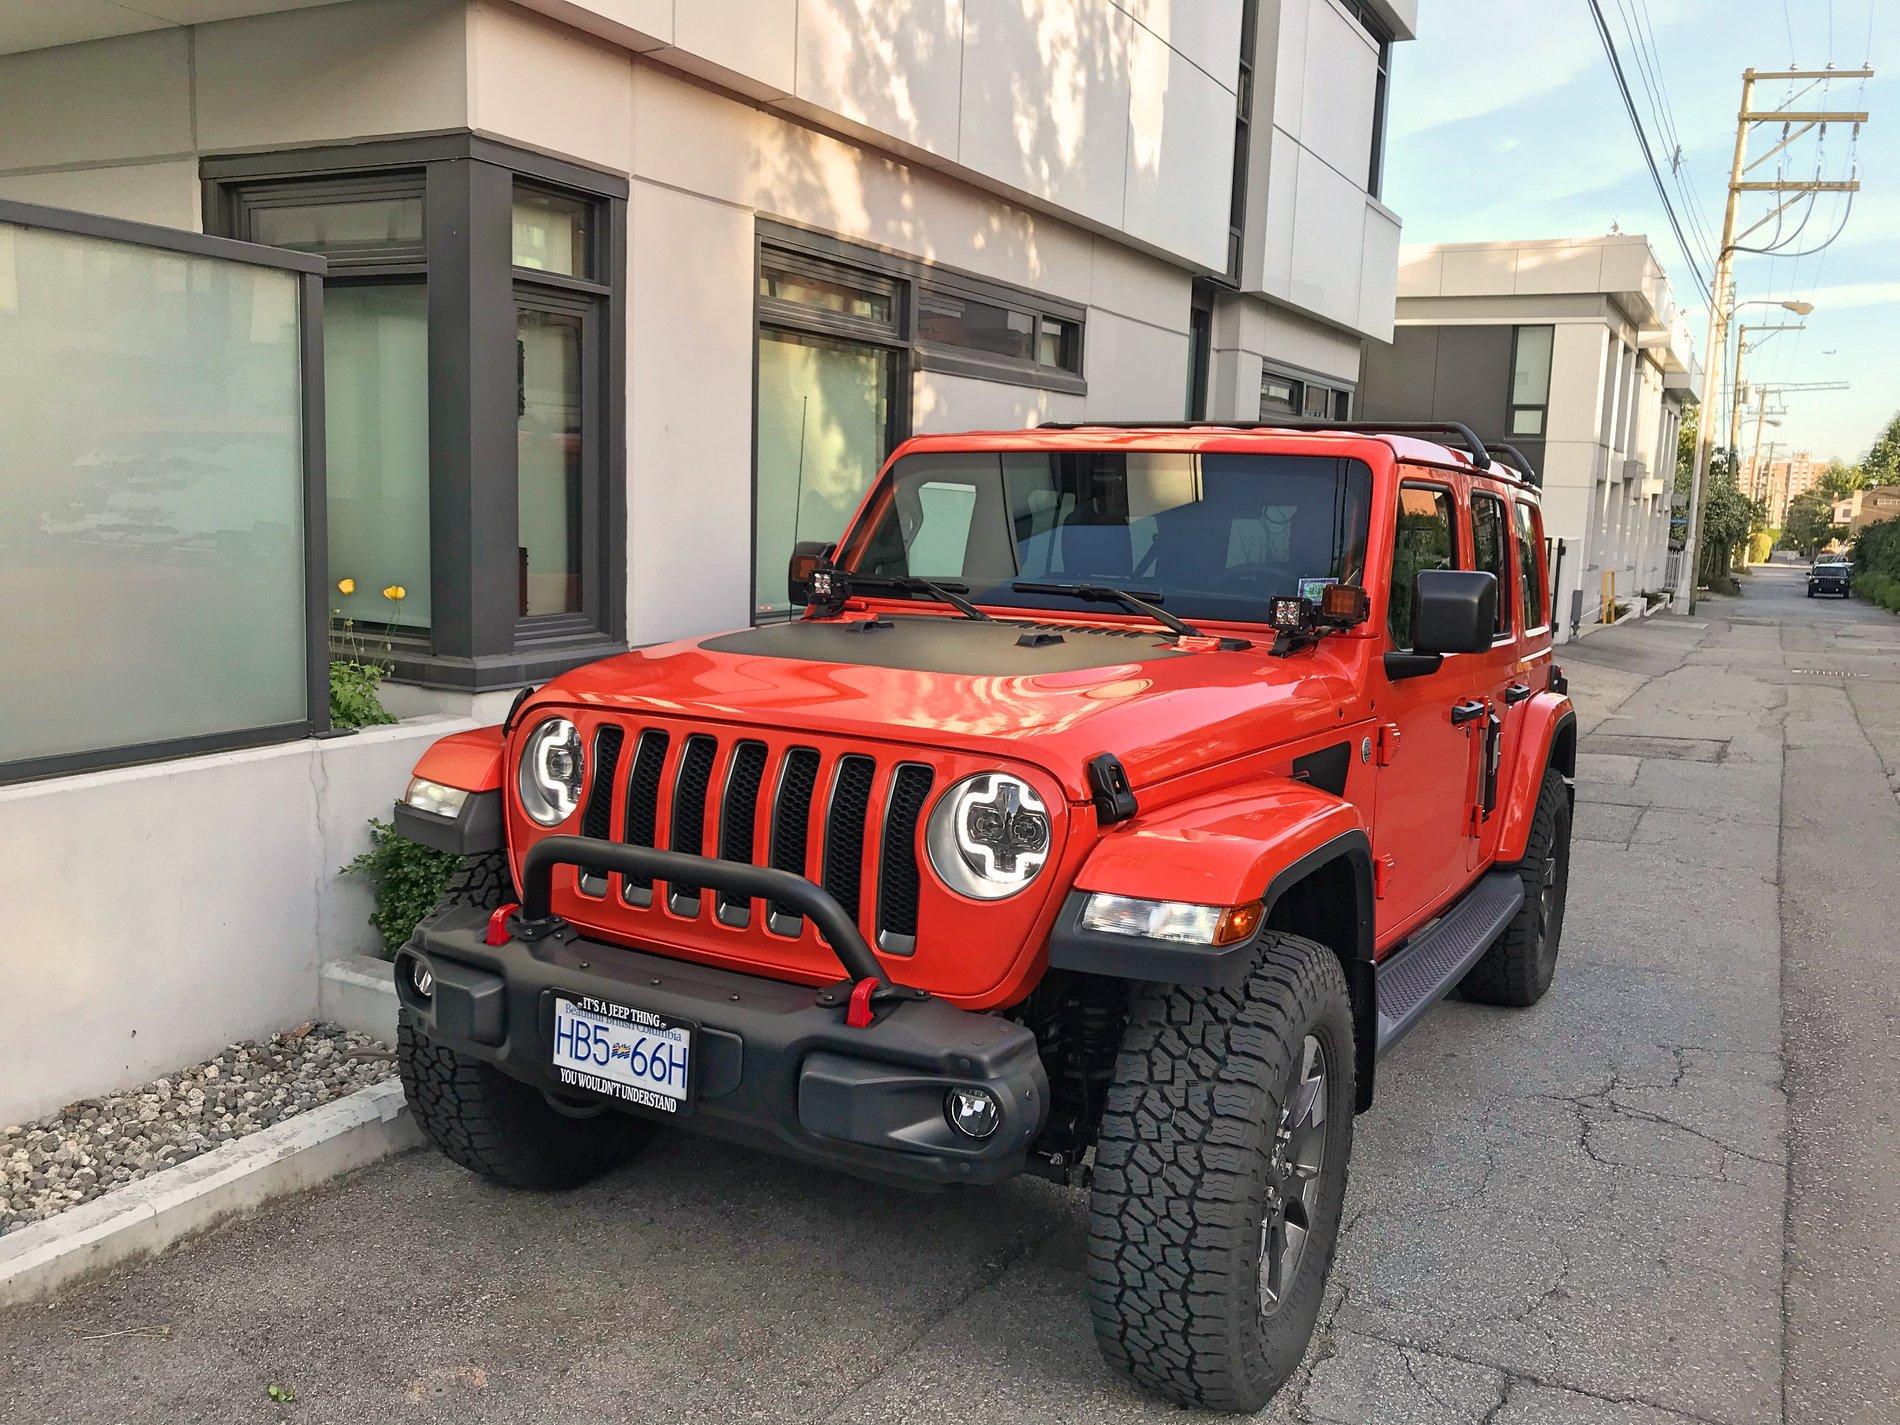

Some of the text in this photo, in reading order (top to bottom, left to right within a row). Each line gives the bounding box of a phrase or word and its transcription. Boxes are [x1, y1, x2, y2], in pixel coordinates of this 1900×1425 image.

[583, 996, 660, 1028] IT'S A JEEP THING
[557, 1016, 688, 1088] HB5 66H
[636, 1024, 682, 1042] Columbia
[560, 1068, 676, 1113] YOU WOULDN'T UNDERSTAND
